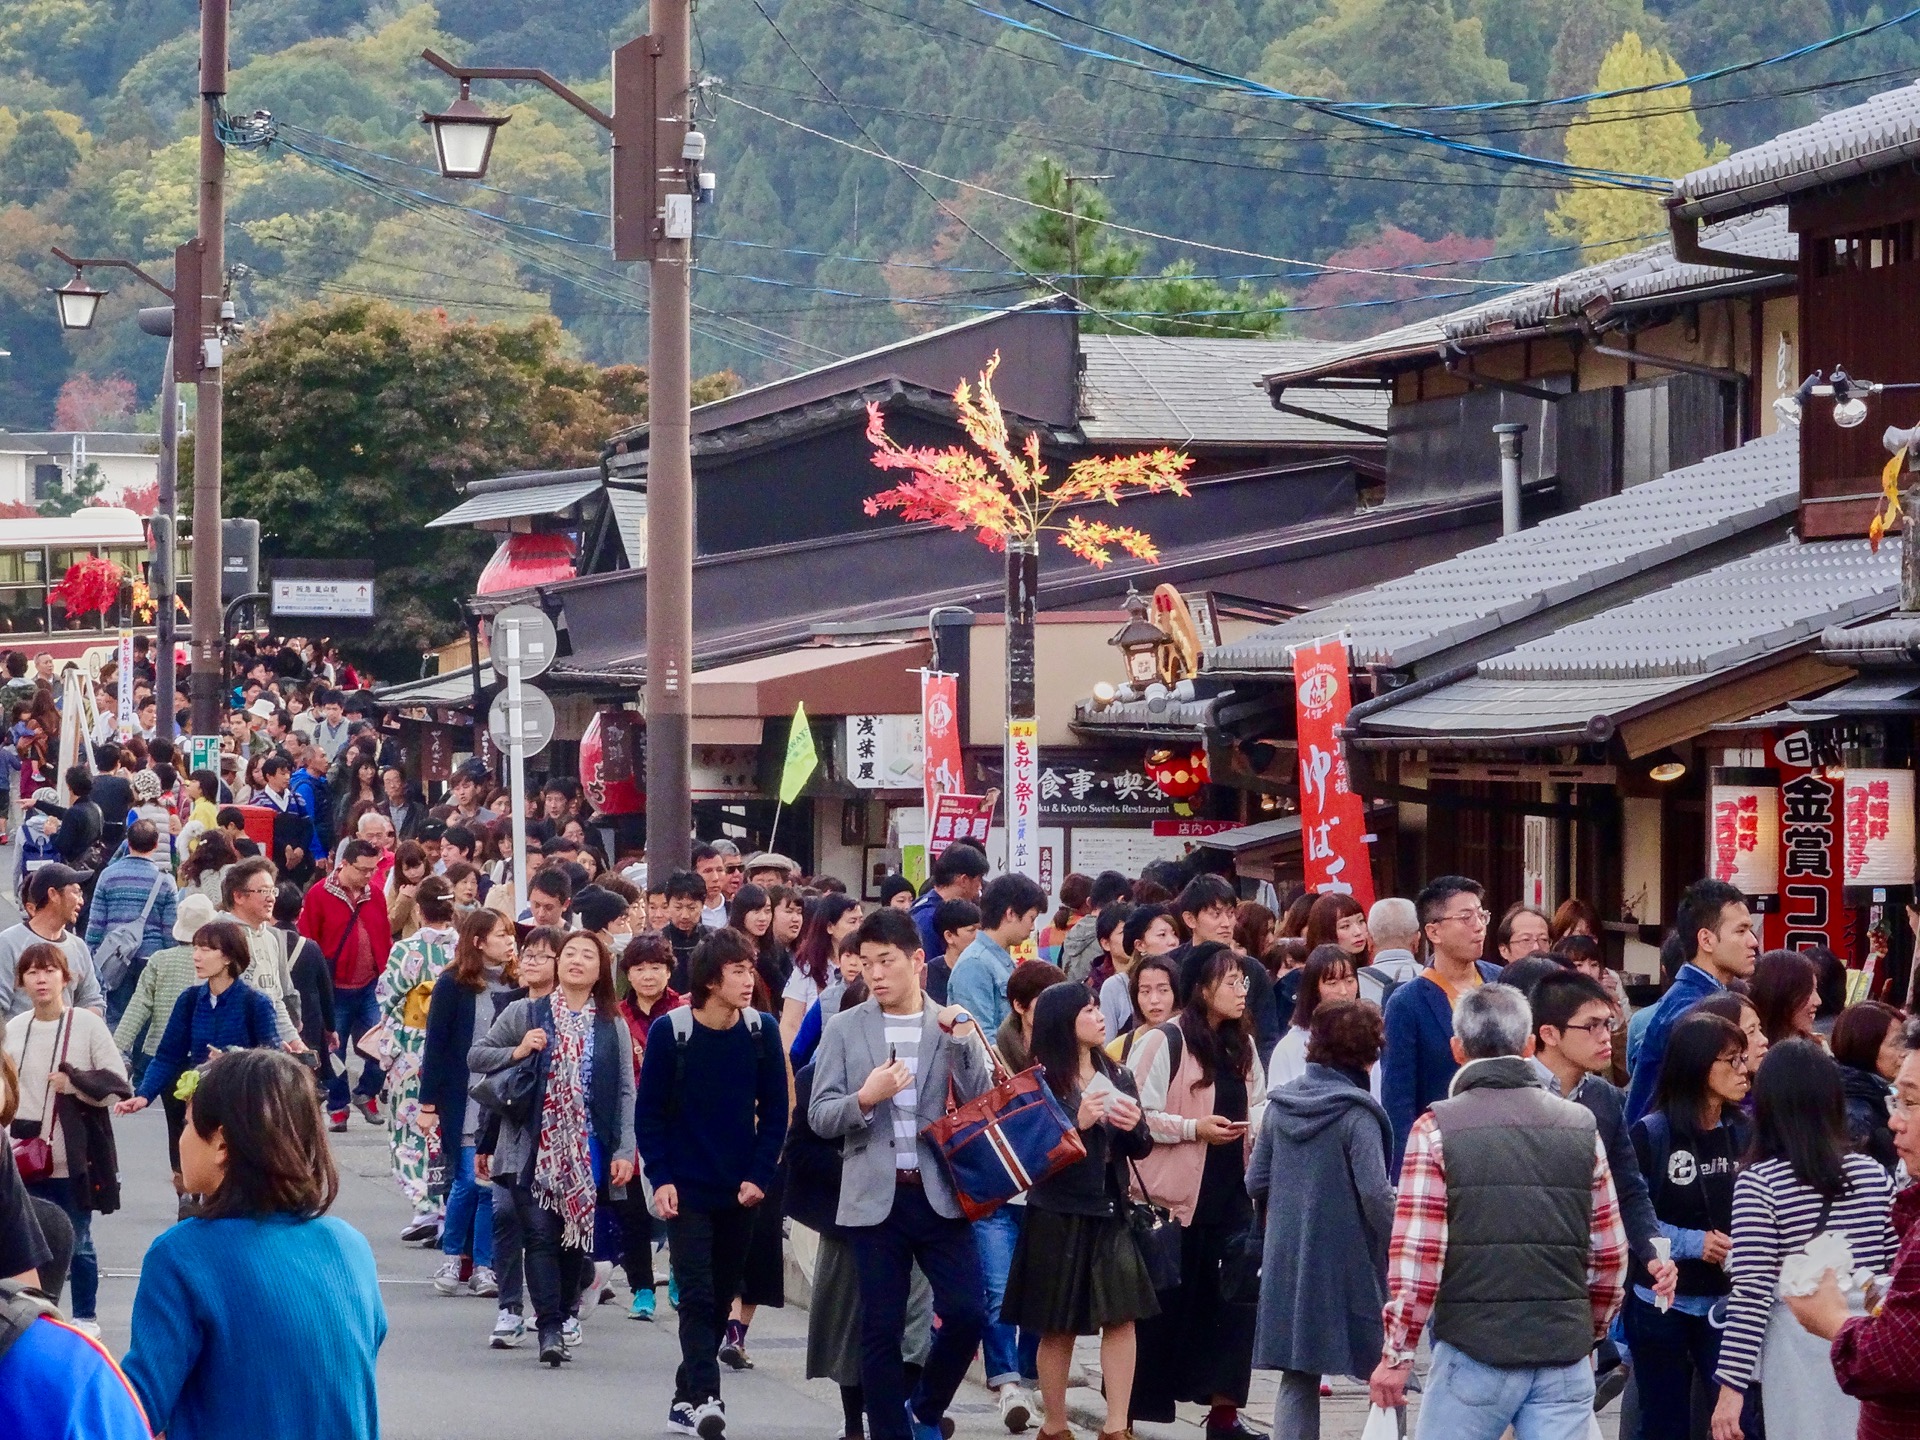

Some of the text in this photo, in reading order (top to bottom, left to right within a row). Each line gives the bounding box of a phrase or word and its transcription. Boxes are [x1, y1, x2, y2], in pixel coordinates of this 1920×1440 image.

[1012, 726, 1032, 737] 嵐山
[1014, 740, 1033, 816] もみじ祭り
[1052, 803, 1059, 812] &
[1061, 803, 1087, 813] Kyoto
[1089, 803, 1121, 813] Sweets
[1122, 804, 1170, 813] Restaurant
